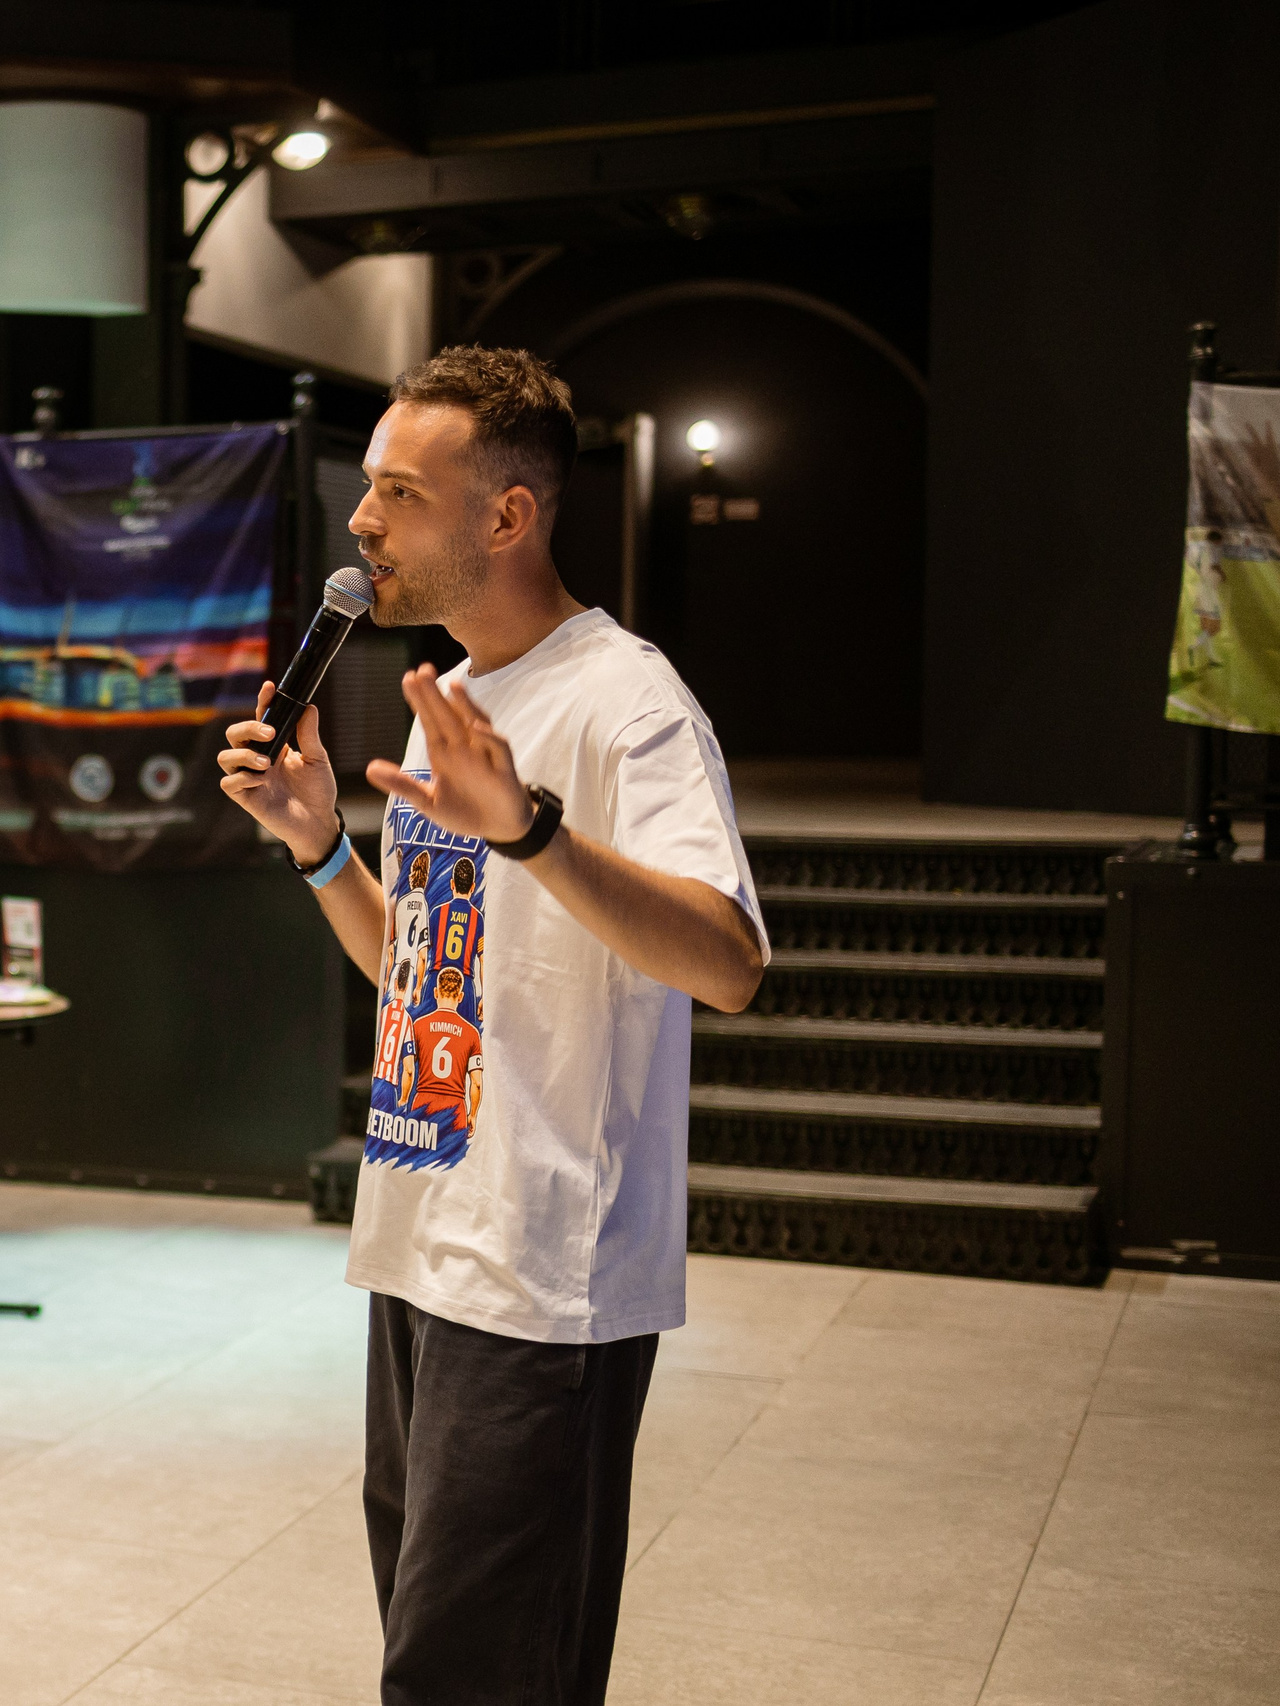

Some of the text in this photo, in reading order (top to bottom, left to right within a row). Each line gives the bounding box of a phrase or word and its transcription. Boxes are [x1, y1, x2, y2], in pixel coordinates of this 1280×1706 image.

[450, 911, 468, 924] XAVI
[407, 914, 418, 948] 6
[445, 924, 465, 960] 6
[429, 1022, 463, 1037] KIMMICH
[383, 1023, 398, 1062] 6
[406, 1043, 413, 1054] C
[431, 1036, 453, 1079] 6
[475, 1057, 481, 1066] C
